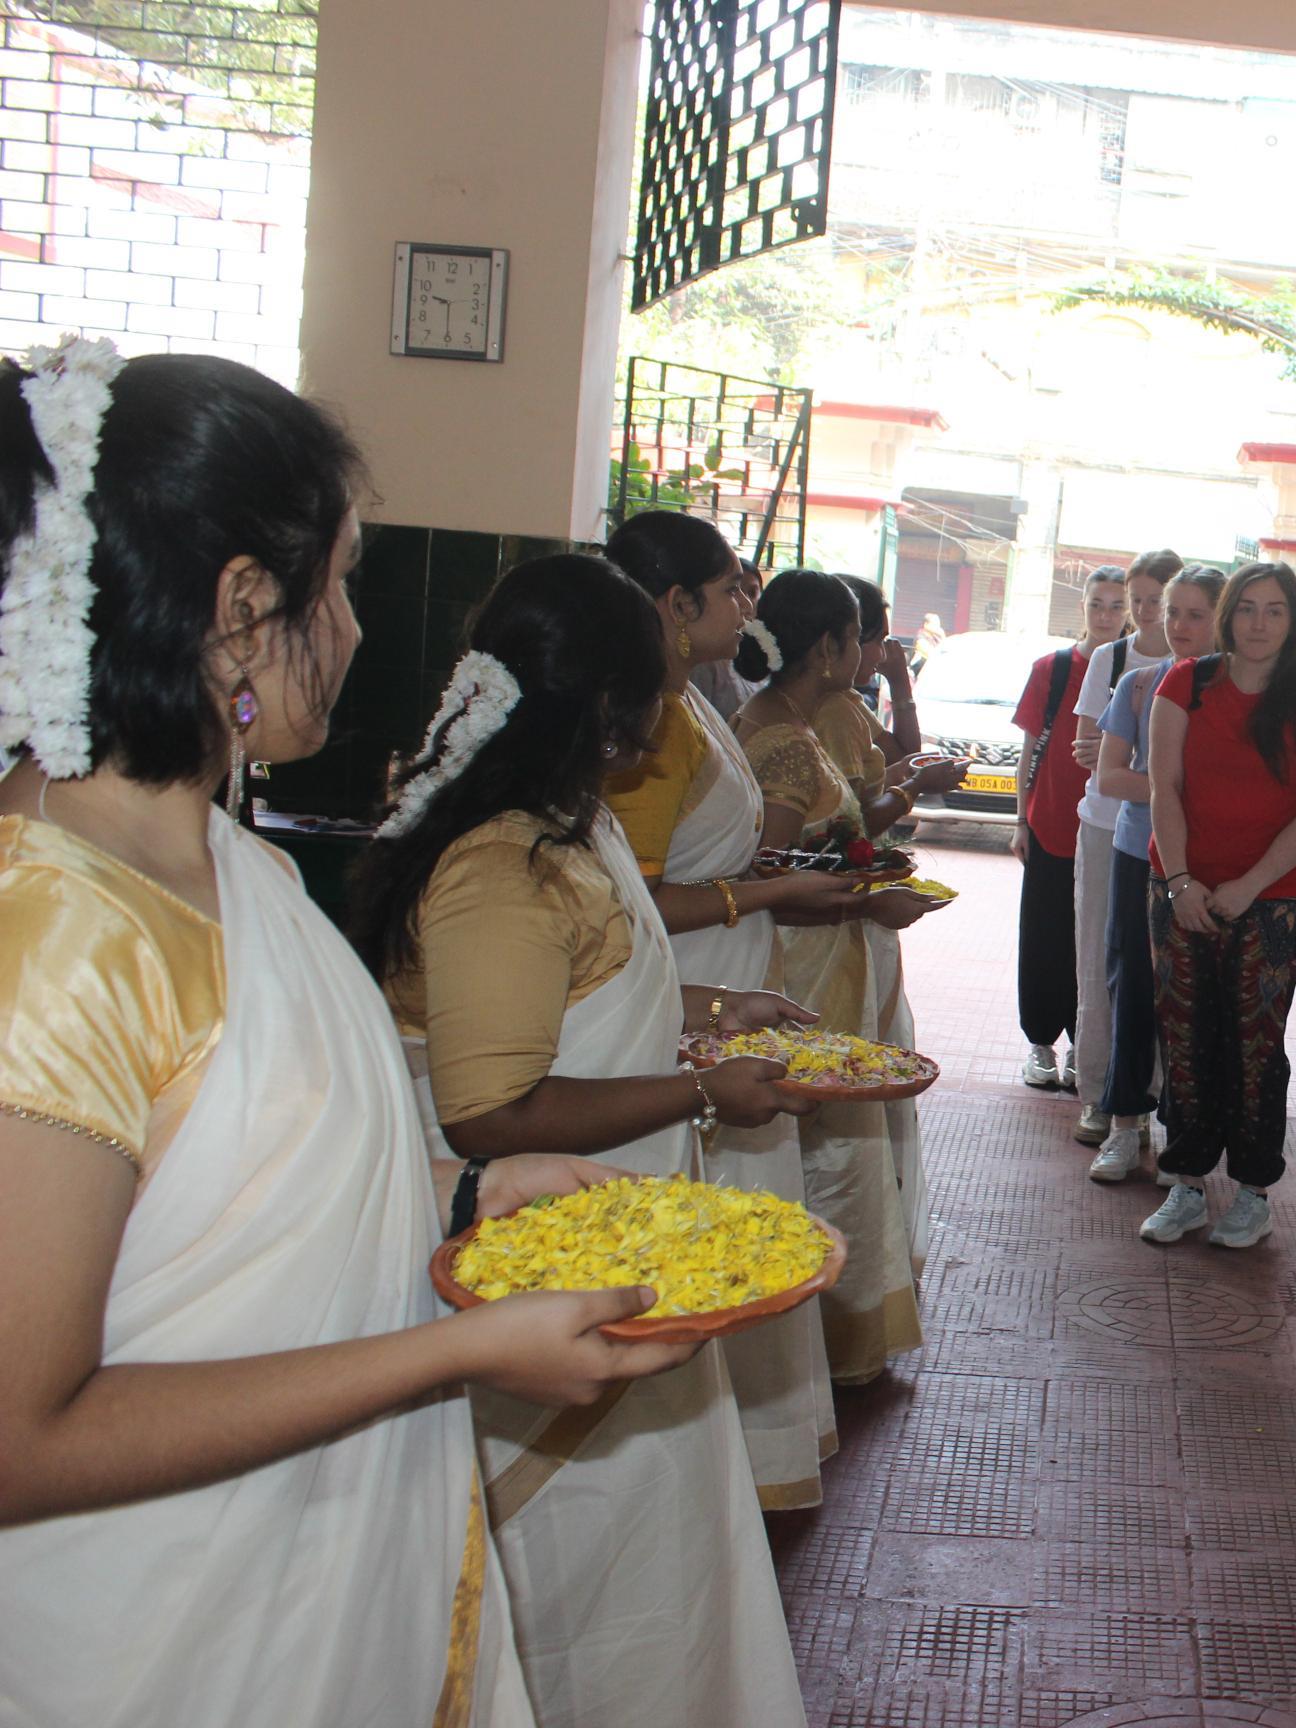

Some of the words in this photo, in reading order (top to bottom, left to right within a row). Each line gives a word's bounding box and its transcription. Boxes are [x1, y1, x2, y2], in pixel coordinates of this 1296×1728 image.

[426, 261, 436, 273] 11
[447, 262, 458, 274] 12
[420, 280, 432, 292] 10
[473, 283, 480, 295] 2
[420, 294, 428, 306] 9
[472, 298, 479, 311] 3
[419, 310, 427, 322] 8
[471, 315, 478, 325] 4
[424, 329, 431, 341] 7
[444, 331, 452, 343] 6
[463, 332, 471, 344] 5
[1036, 727, 1051, 751] PINK
